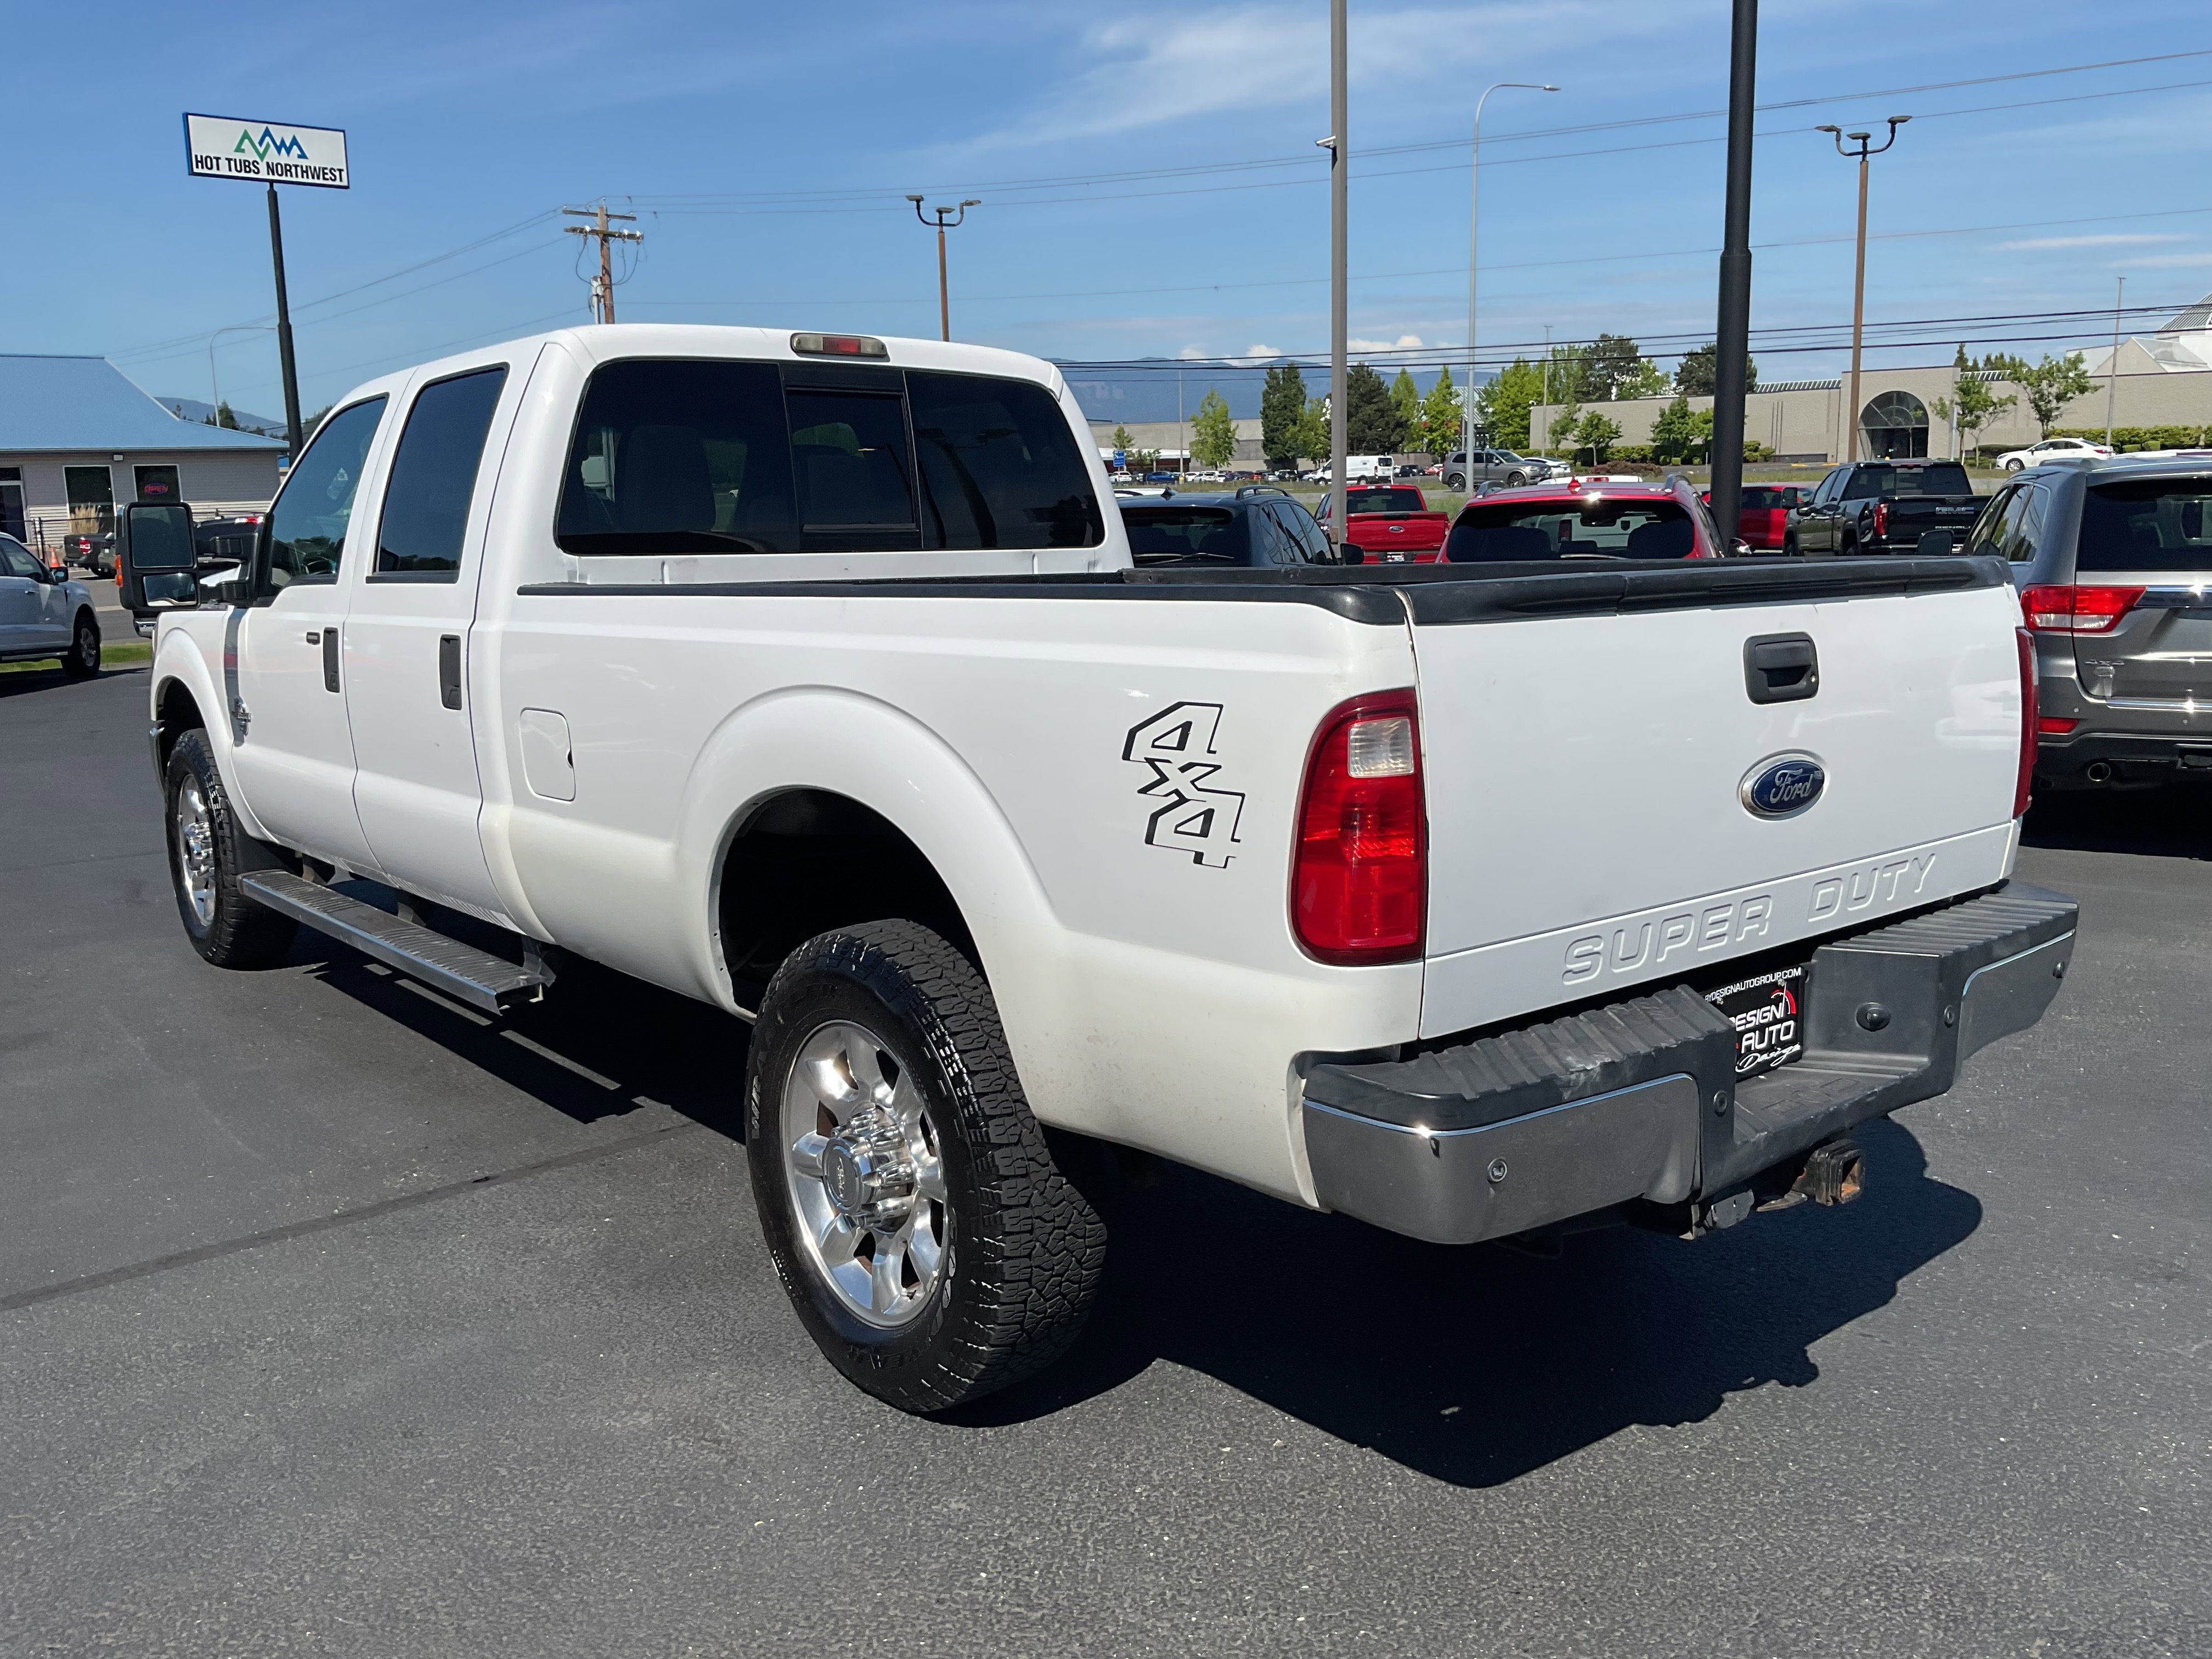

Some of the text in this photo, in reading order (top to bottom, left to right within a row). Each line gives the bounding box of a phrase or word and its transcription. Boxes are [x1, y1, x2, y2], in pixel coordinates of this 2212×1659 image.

[194, 154, 345, 182] HOT TUBS NORTHWEST
[1770, 768, 1814, 804] Ford
[1562, 853, 1936, 985] SUPER DUTY
[1741, 1020, 1795, 1054] AUTO
